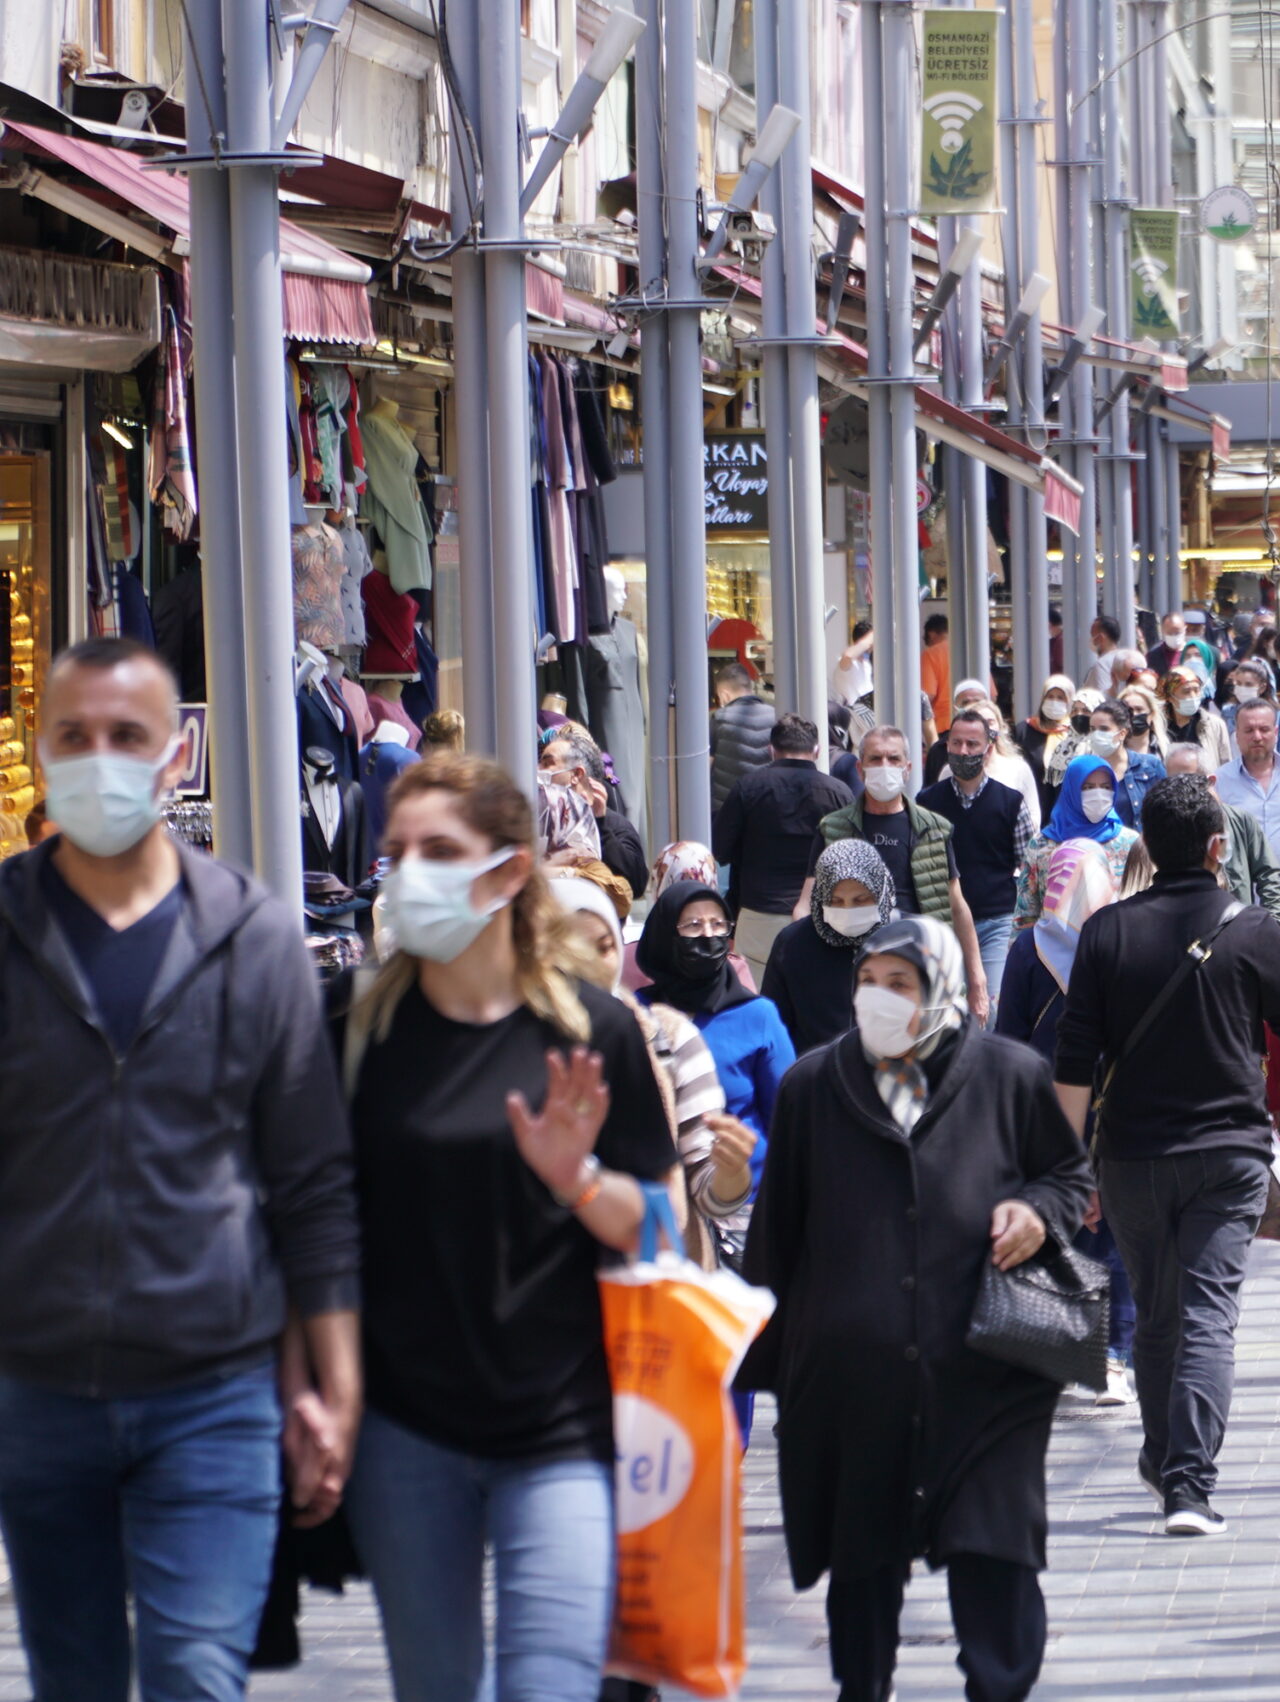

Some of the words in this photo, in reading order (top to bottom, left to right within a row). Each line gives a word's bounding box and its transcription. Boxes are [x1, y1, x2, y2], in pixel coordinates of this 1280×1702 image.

[927, 32, 990, 43] OSMANGAZİ
[927, 44, 990, 56] BELEDİYESİ
[927, 56, 989, 71] ÜCRETSİZ
[873, 832, 899, 847] Dior
